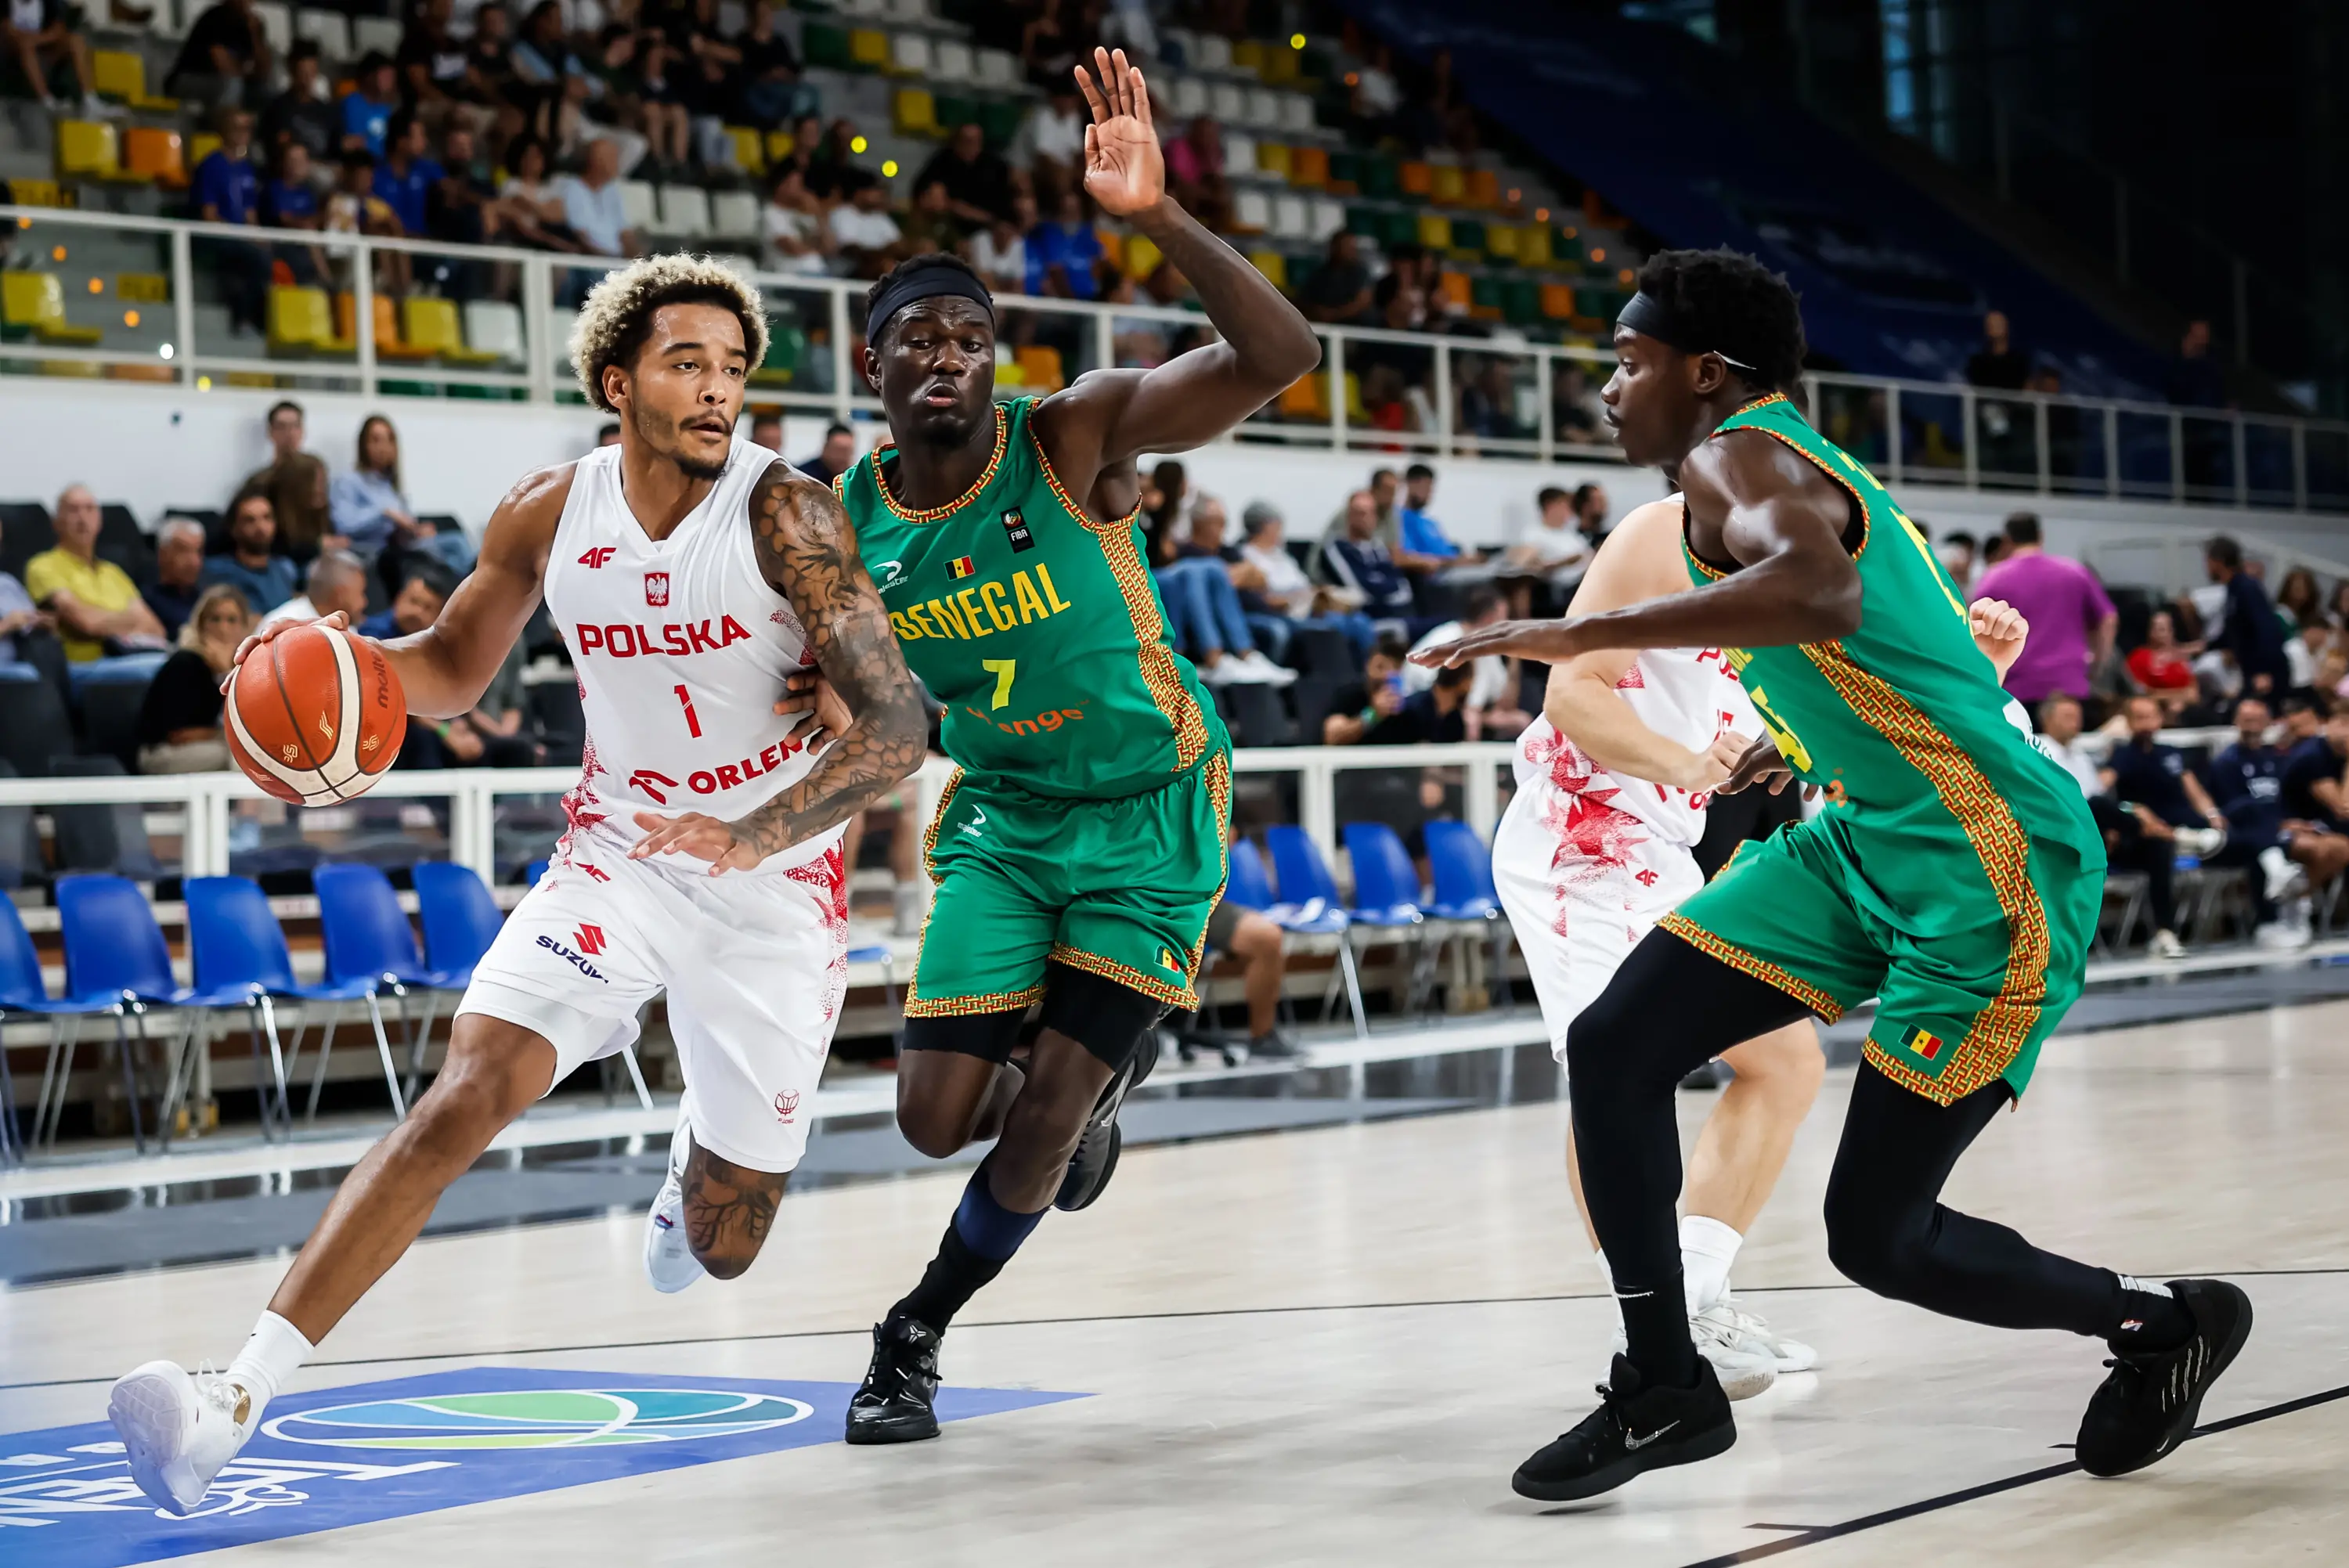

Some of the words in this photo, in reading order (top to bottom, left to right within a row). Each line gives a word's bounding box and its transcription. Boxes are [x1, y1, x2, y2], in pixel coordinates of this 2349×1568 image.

[1011, 529, 1028, 541] FIBA
[578, 547, 616, 568] 4F
[889, 563, 1071, 640] SENEGAL
[576, 614, 752, 658] POLSKA
[982, 659, 1016, 711] 7
[674, 684, 702, 738] 1
[1635, 869, 1659, 887] 4F
